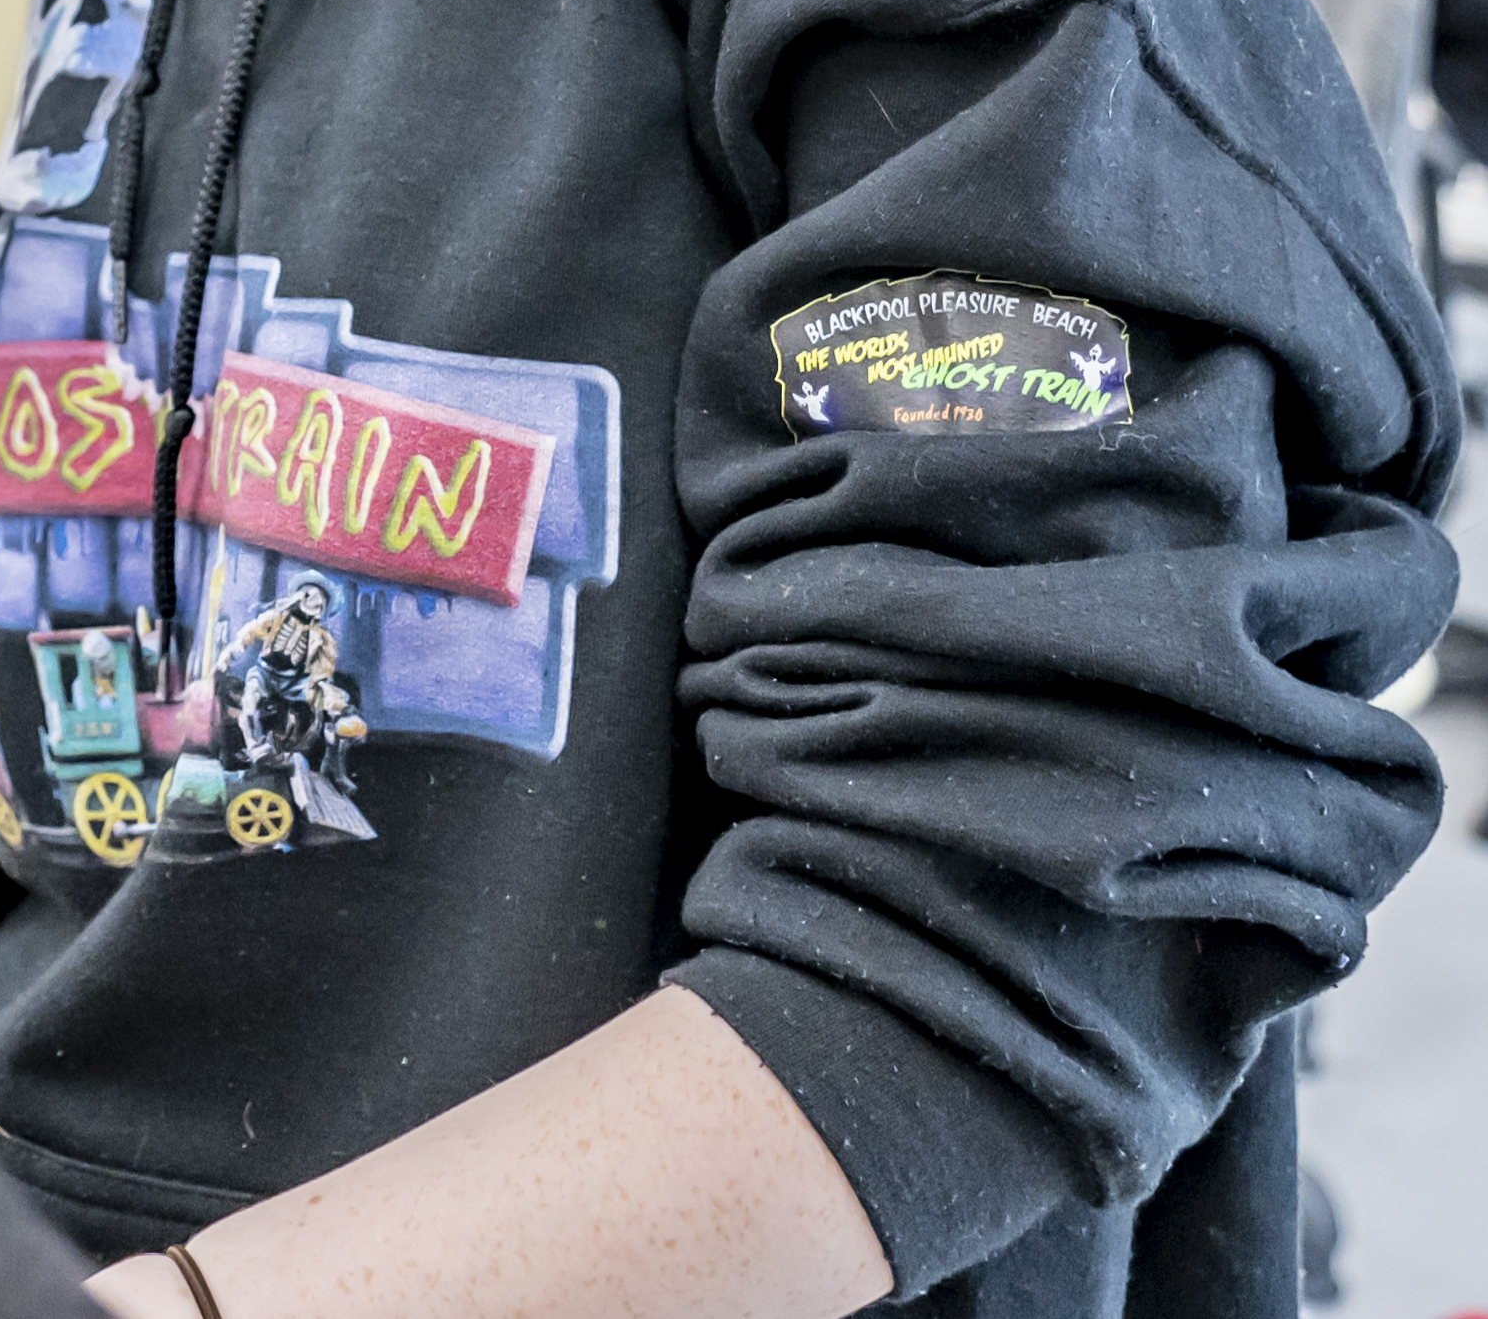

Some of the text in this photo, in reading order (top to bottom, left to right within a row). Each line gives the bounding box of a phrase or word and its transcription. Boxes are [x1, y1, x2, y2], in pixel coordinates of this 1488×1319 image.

[804, 291, 1098, 344] BLACKPOOL PLEASURE BEACH
[795, 329, 909, 373] THE WORLDS
[867, 332, 1004, 384] MOST HAUNTED
[894, 403, 985, 423] Founded 1930
[900, 362, 1111, 417] GHOST TRAIN
